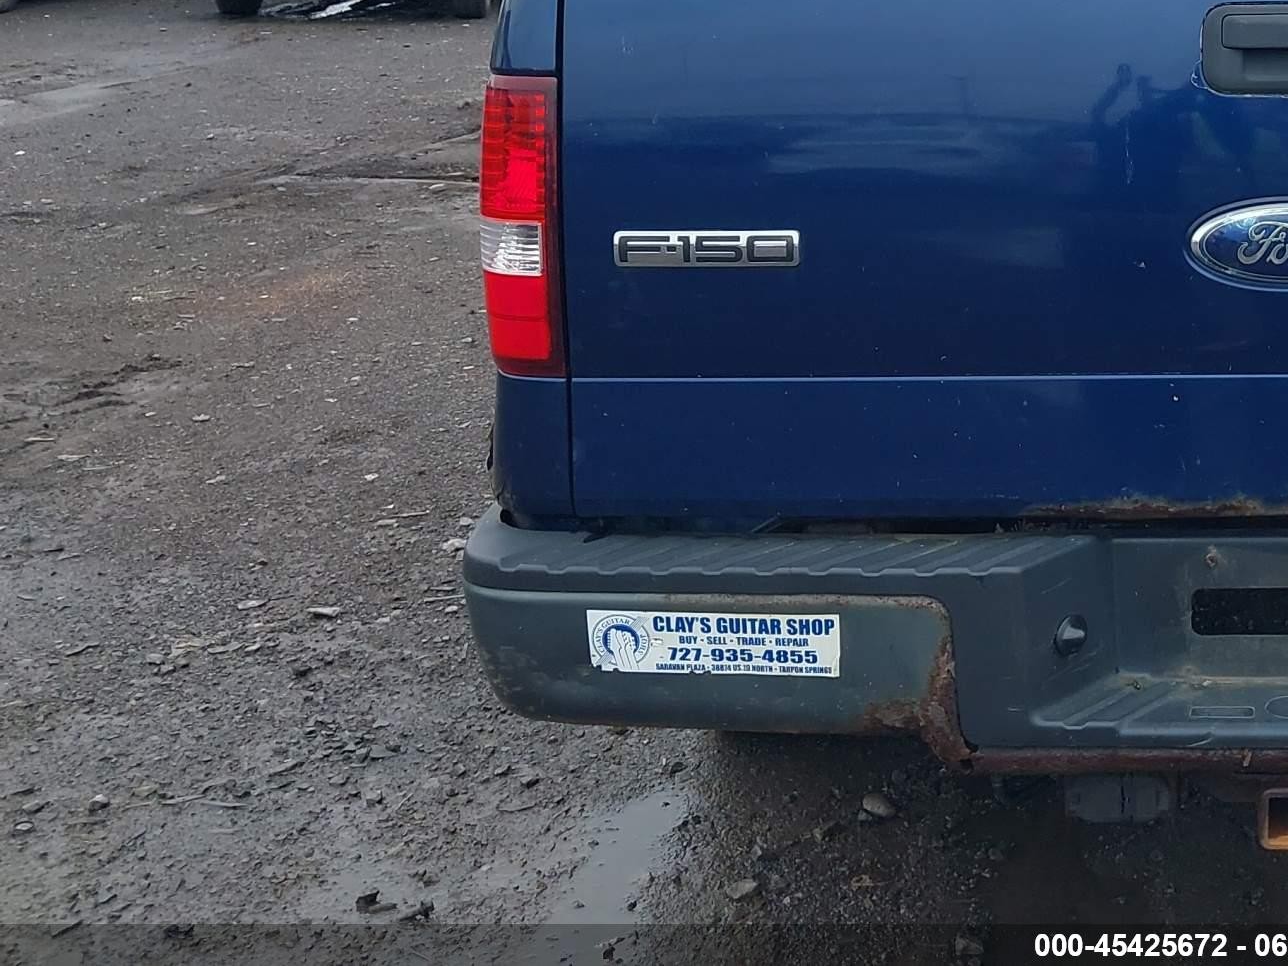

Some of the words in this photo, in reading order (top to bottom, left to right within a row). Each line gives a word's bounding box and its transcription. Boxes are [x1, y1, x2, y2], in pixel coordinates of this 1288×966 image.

[618, 235, 795, 263] F-150
[601, 617, 631, 628] GUITAR
[652, 616, 711, 633] CLAY'S
[716, 617, 781, 635] GUITAR
[786, 618, 835, 635] SHOP
[679, 635, 698, 644] BUY
[706, 636, 727, 645] SELL
[736, 637, 766, 646] TRADE
[775, 637, 809, 647] REPAIR
[667, 646, 818, 664] 727-935-4855
[686, 663, 706, 671] PLAZA
[804, 666, 832, 674] SPRINGS
